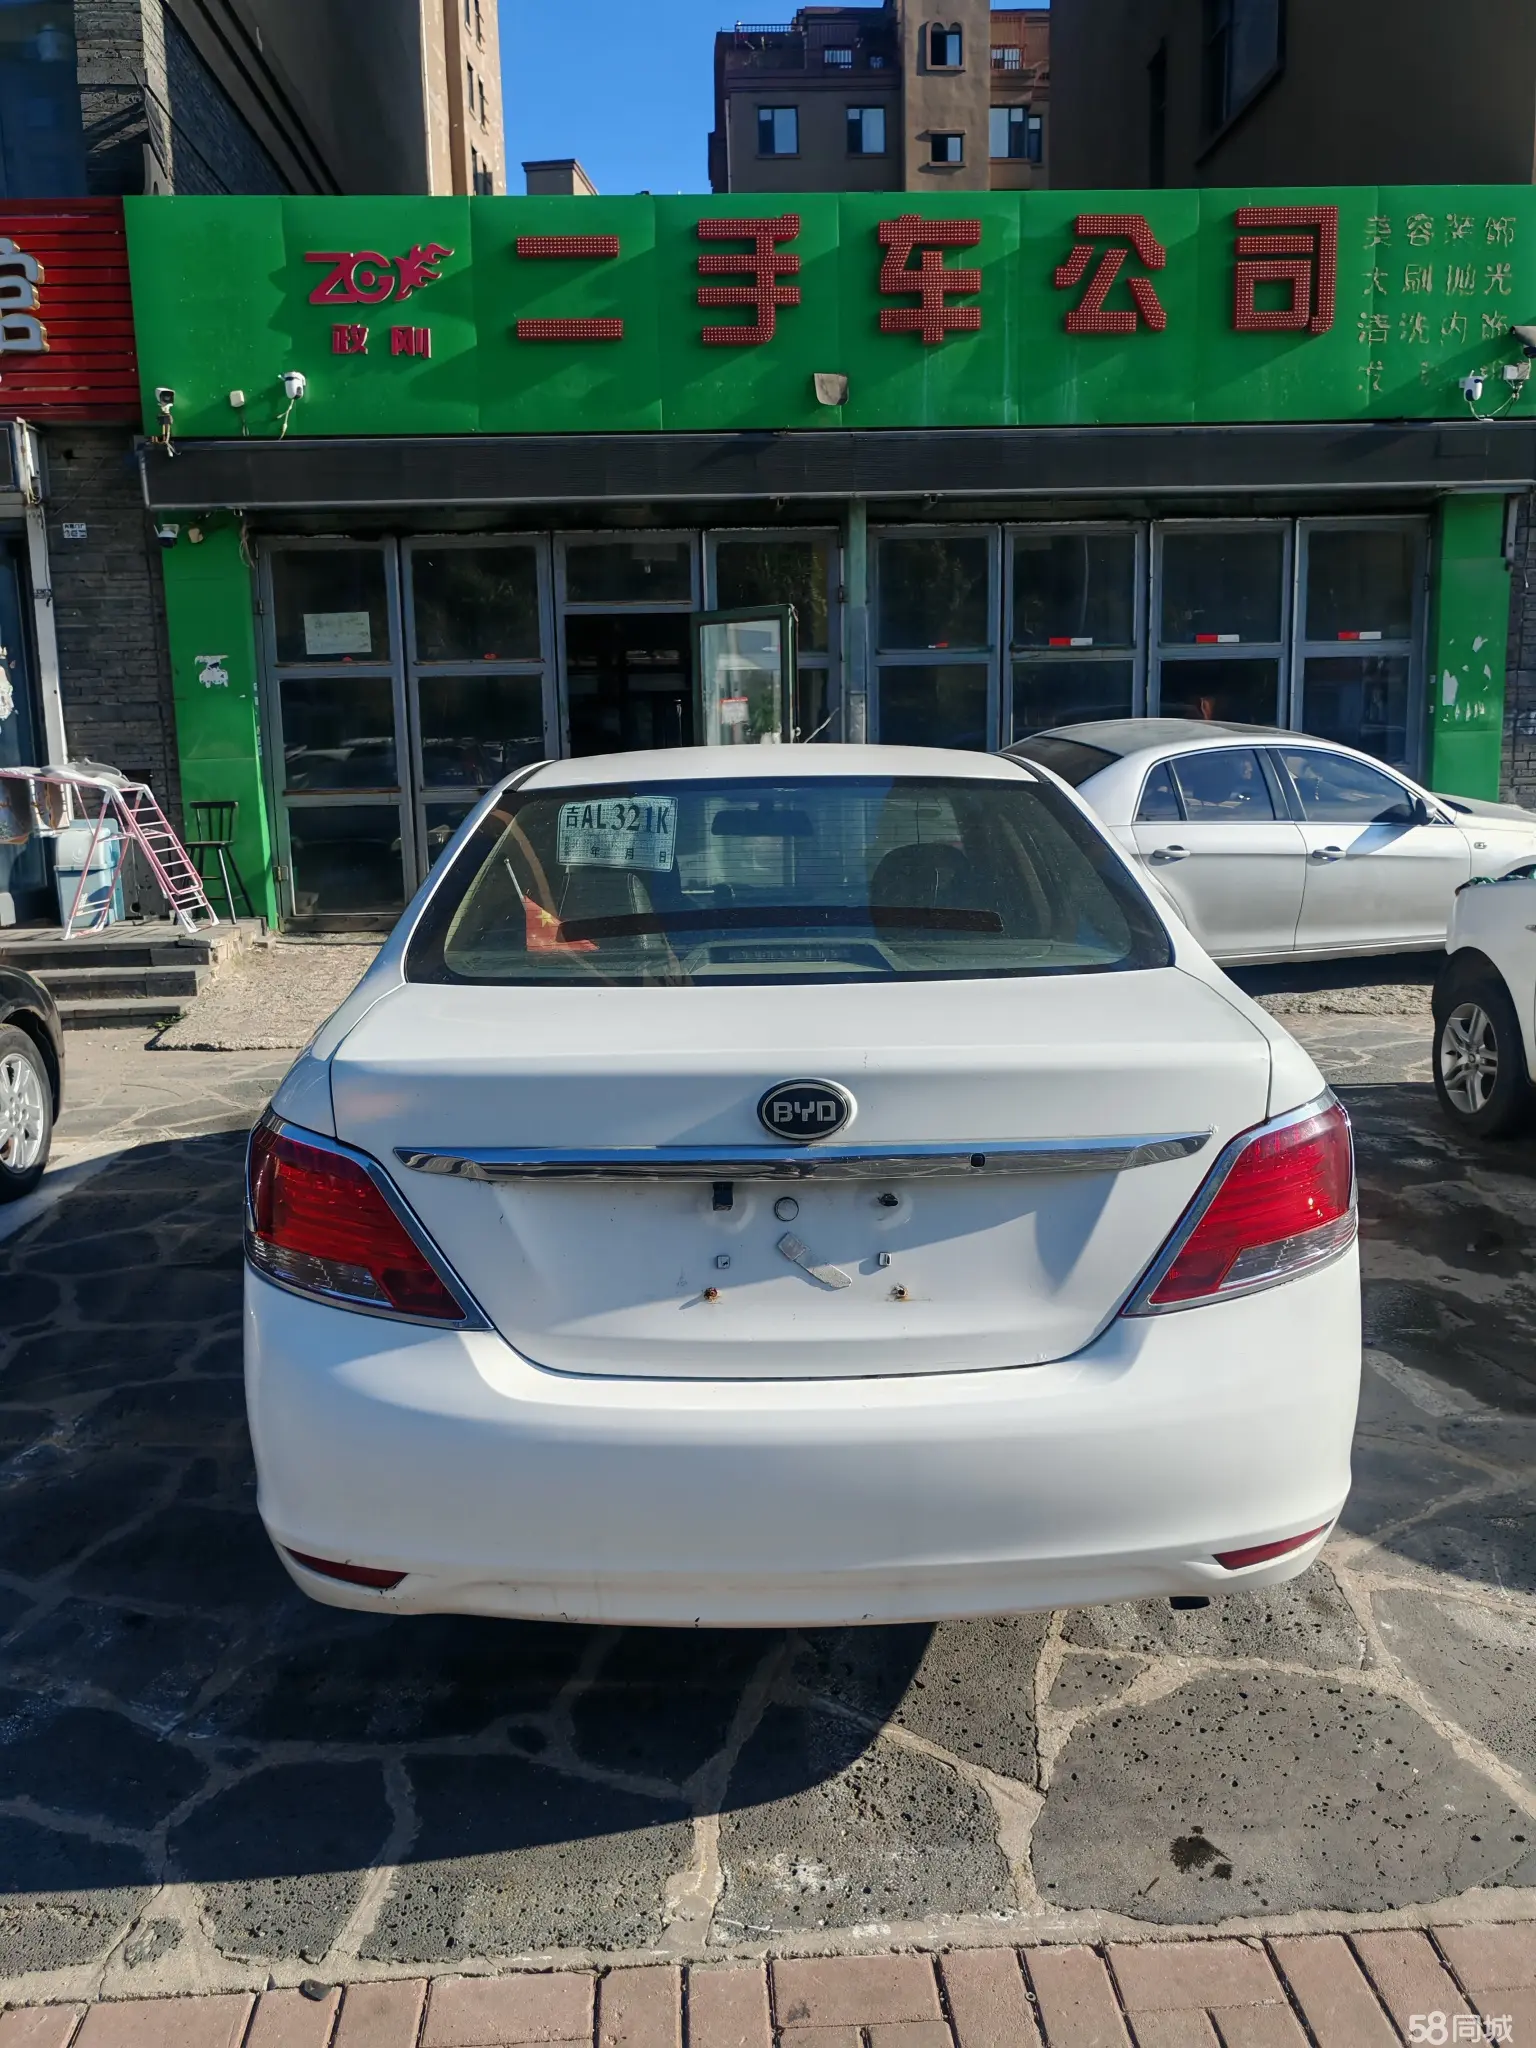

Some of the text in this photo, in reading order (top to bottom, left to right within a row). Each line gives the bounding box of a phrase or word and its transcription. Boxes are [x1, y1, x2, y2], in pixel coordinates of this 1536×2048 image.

[515, 204, 1339, 345] 二手车公司
[331, 323, 432, 359] 政刚
[772, 1100, 837, 1123] BYD
